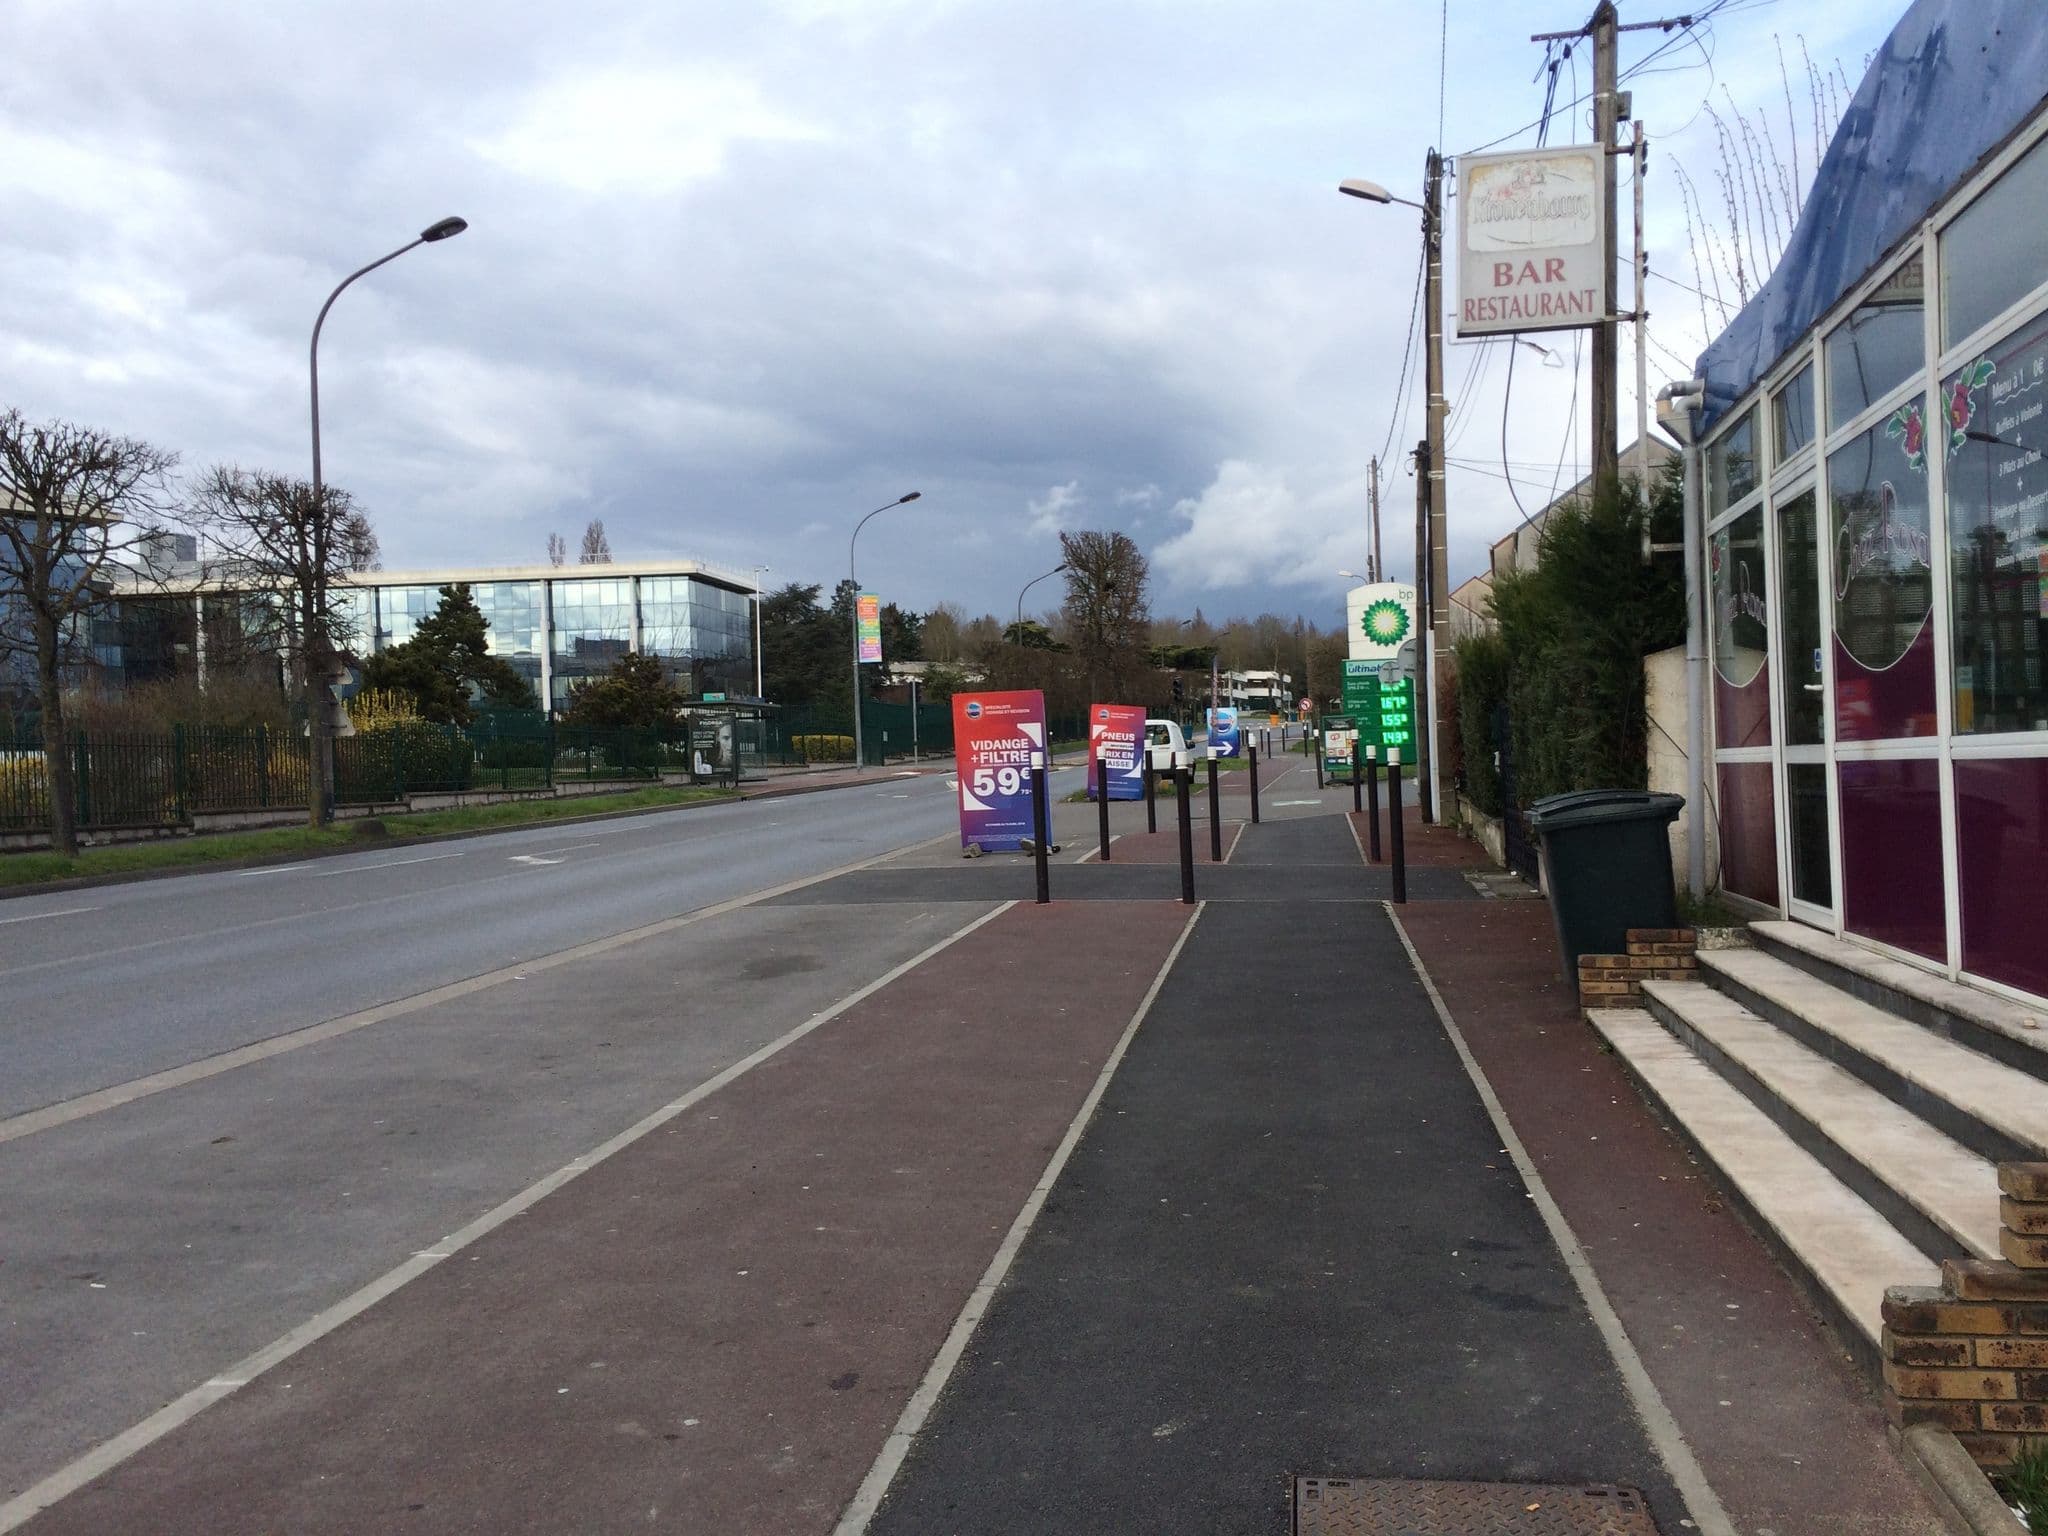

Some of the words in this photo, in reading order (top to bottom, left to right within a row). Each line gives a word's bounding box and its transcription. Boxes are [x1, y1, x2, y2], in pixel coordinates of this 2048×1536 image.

[1493, 257, 1567, 288] BAR
[1464, 288, 1597, 322] RESTAURANT
[1992, 378, 2012, 400] Menu
[1398, 588, 1414, 601] bp
[1347, 664, 1381, 674] ultimat
[1101, 731, 1135, 741] PNEUS
[970, 738, 1029, 751] VIDANGE
[1104, 750, 1121, 759] RIX
[1121, 751, 1135, 759] EN
[1105, 759, 1129, 768] AISSE
